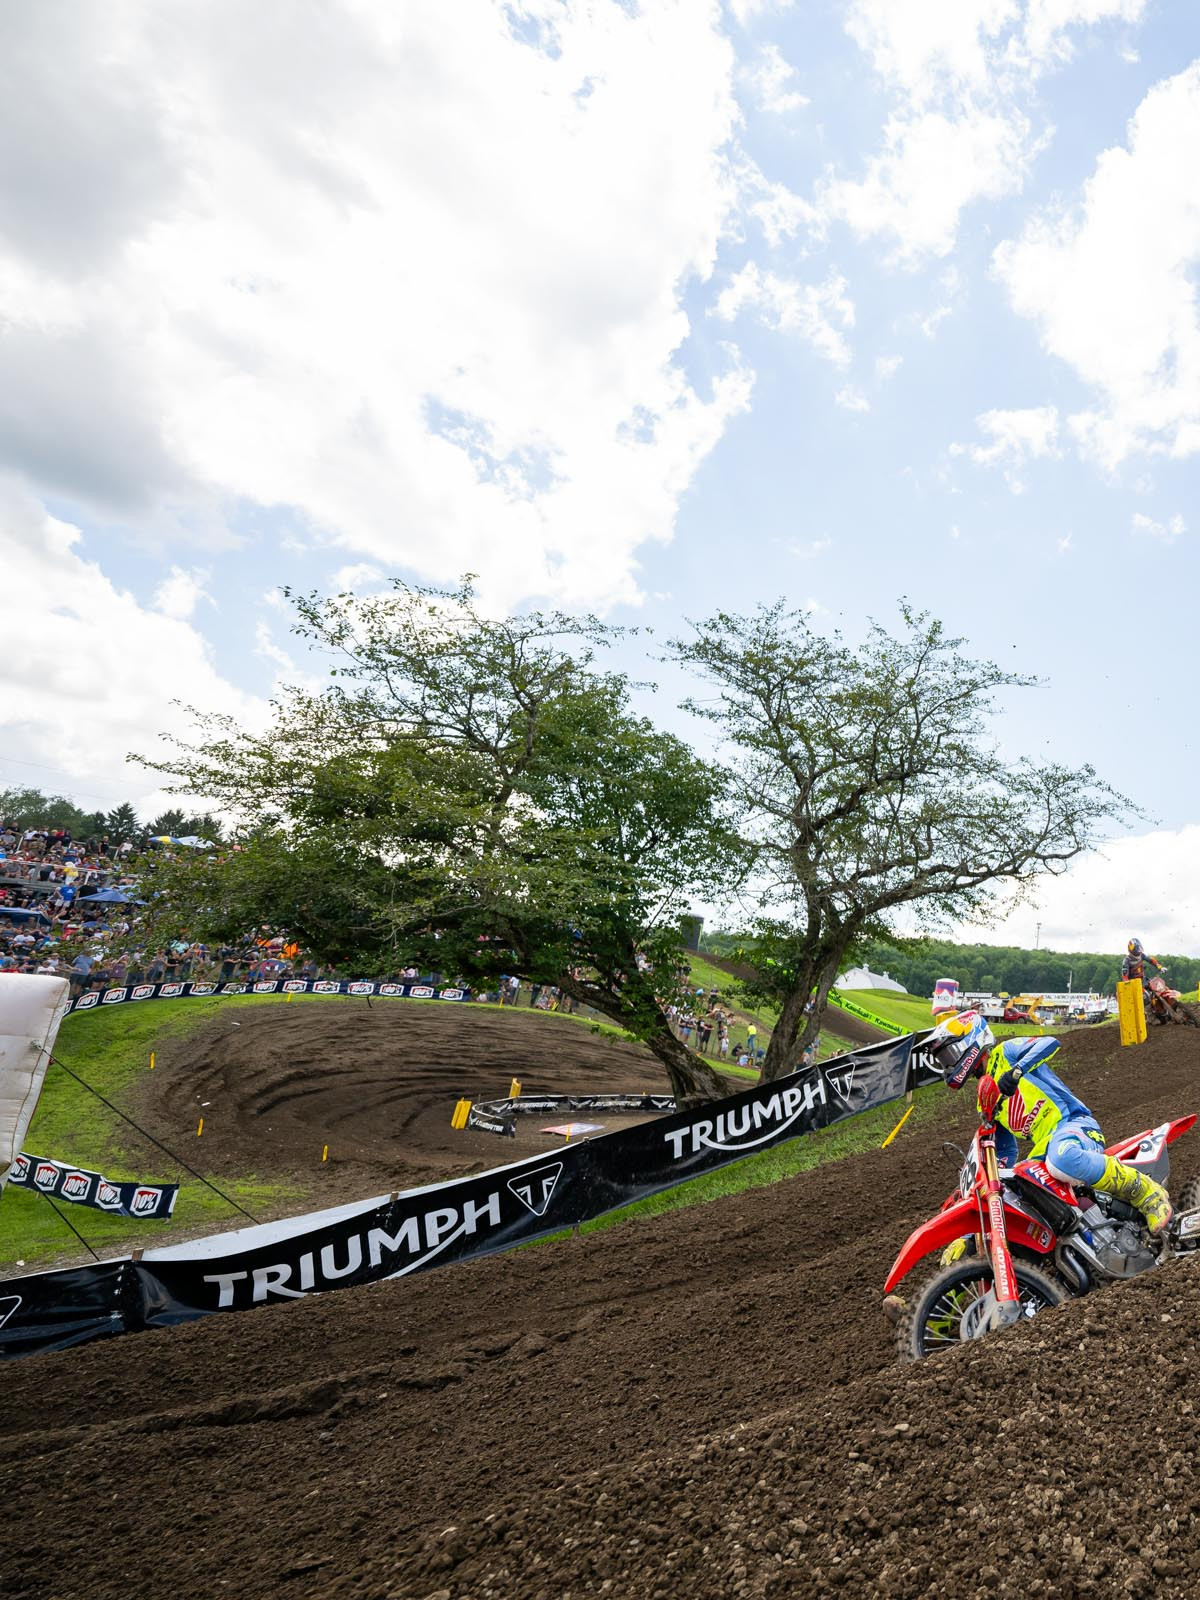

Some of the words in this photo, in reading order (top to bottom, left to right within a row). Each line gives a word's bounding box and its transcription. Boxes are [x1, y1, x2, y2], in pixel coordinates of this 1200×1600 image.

[664, 1079, 827, 1159] TRIUMPH
[37, 1168, 57, 1186] 100%
[64, 1178, 87, 1196] 100%
[184, 1192, 501, 1307] TRIUMPH
[997, 1247, 1009, 1295] DUNLOP
